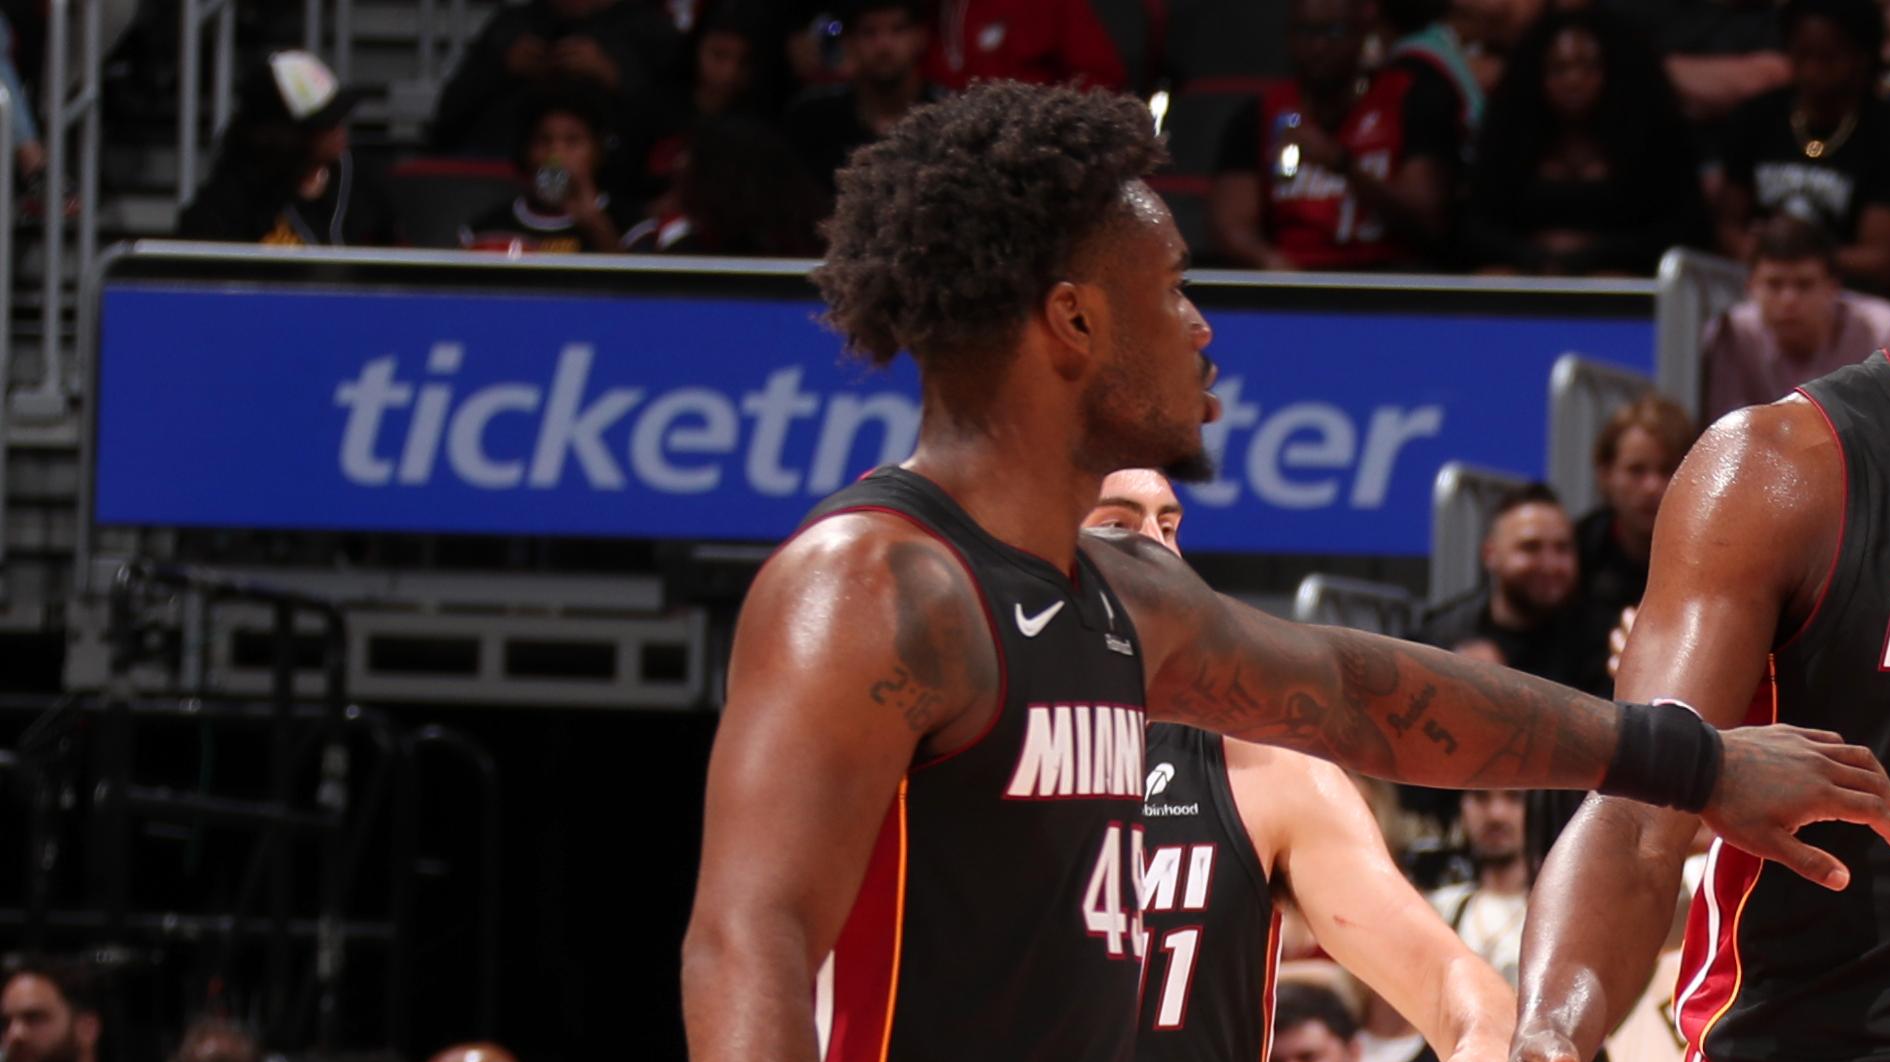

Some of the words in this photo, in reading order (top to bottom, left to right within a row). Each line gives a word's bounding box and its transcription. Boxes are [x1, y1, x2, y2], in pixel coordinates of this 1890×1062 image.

[335, 342, 1444, 510] ticketmter
[1004, 703, 1143, 799] MIAM
[1142, 802, 1199, 817] binhood
